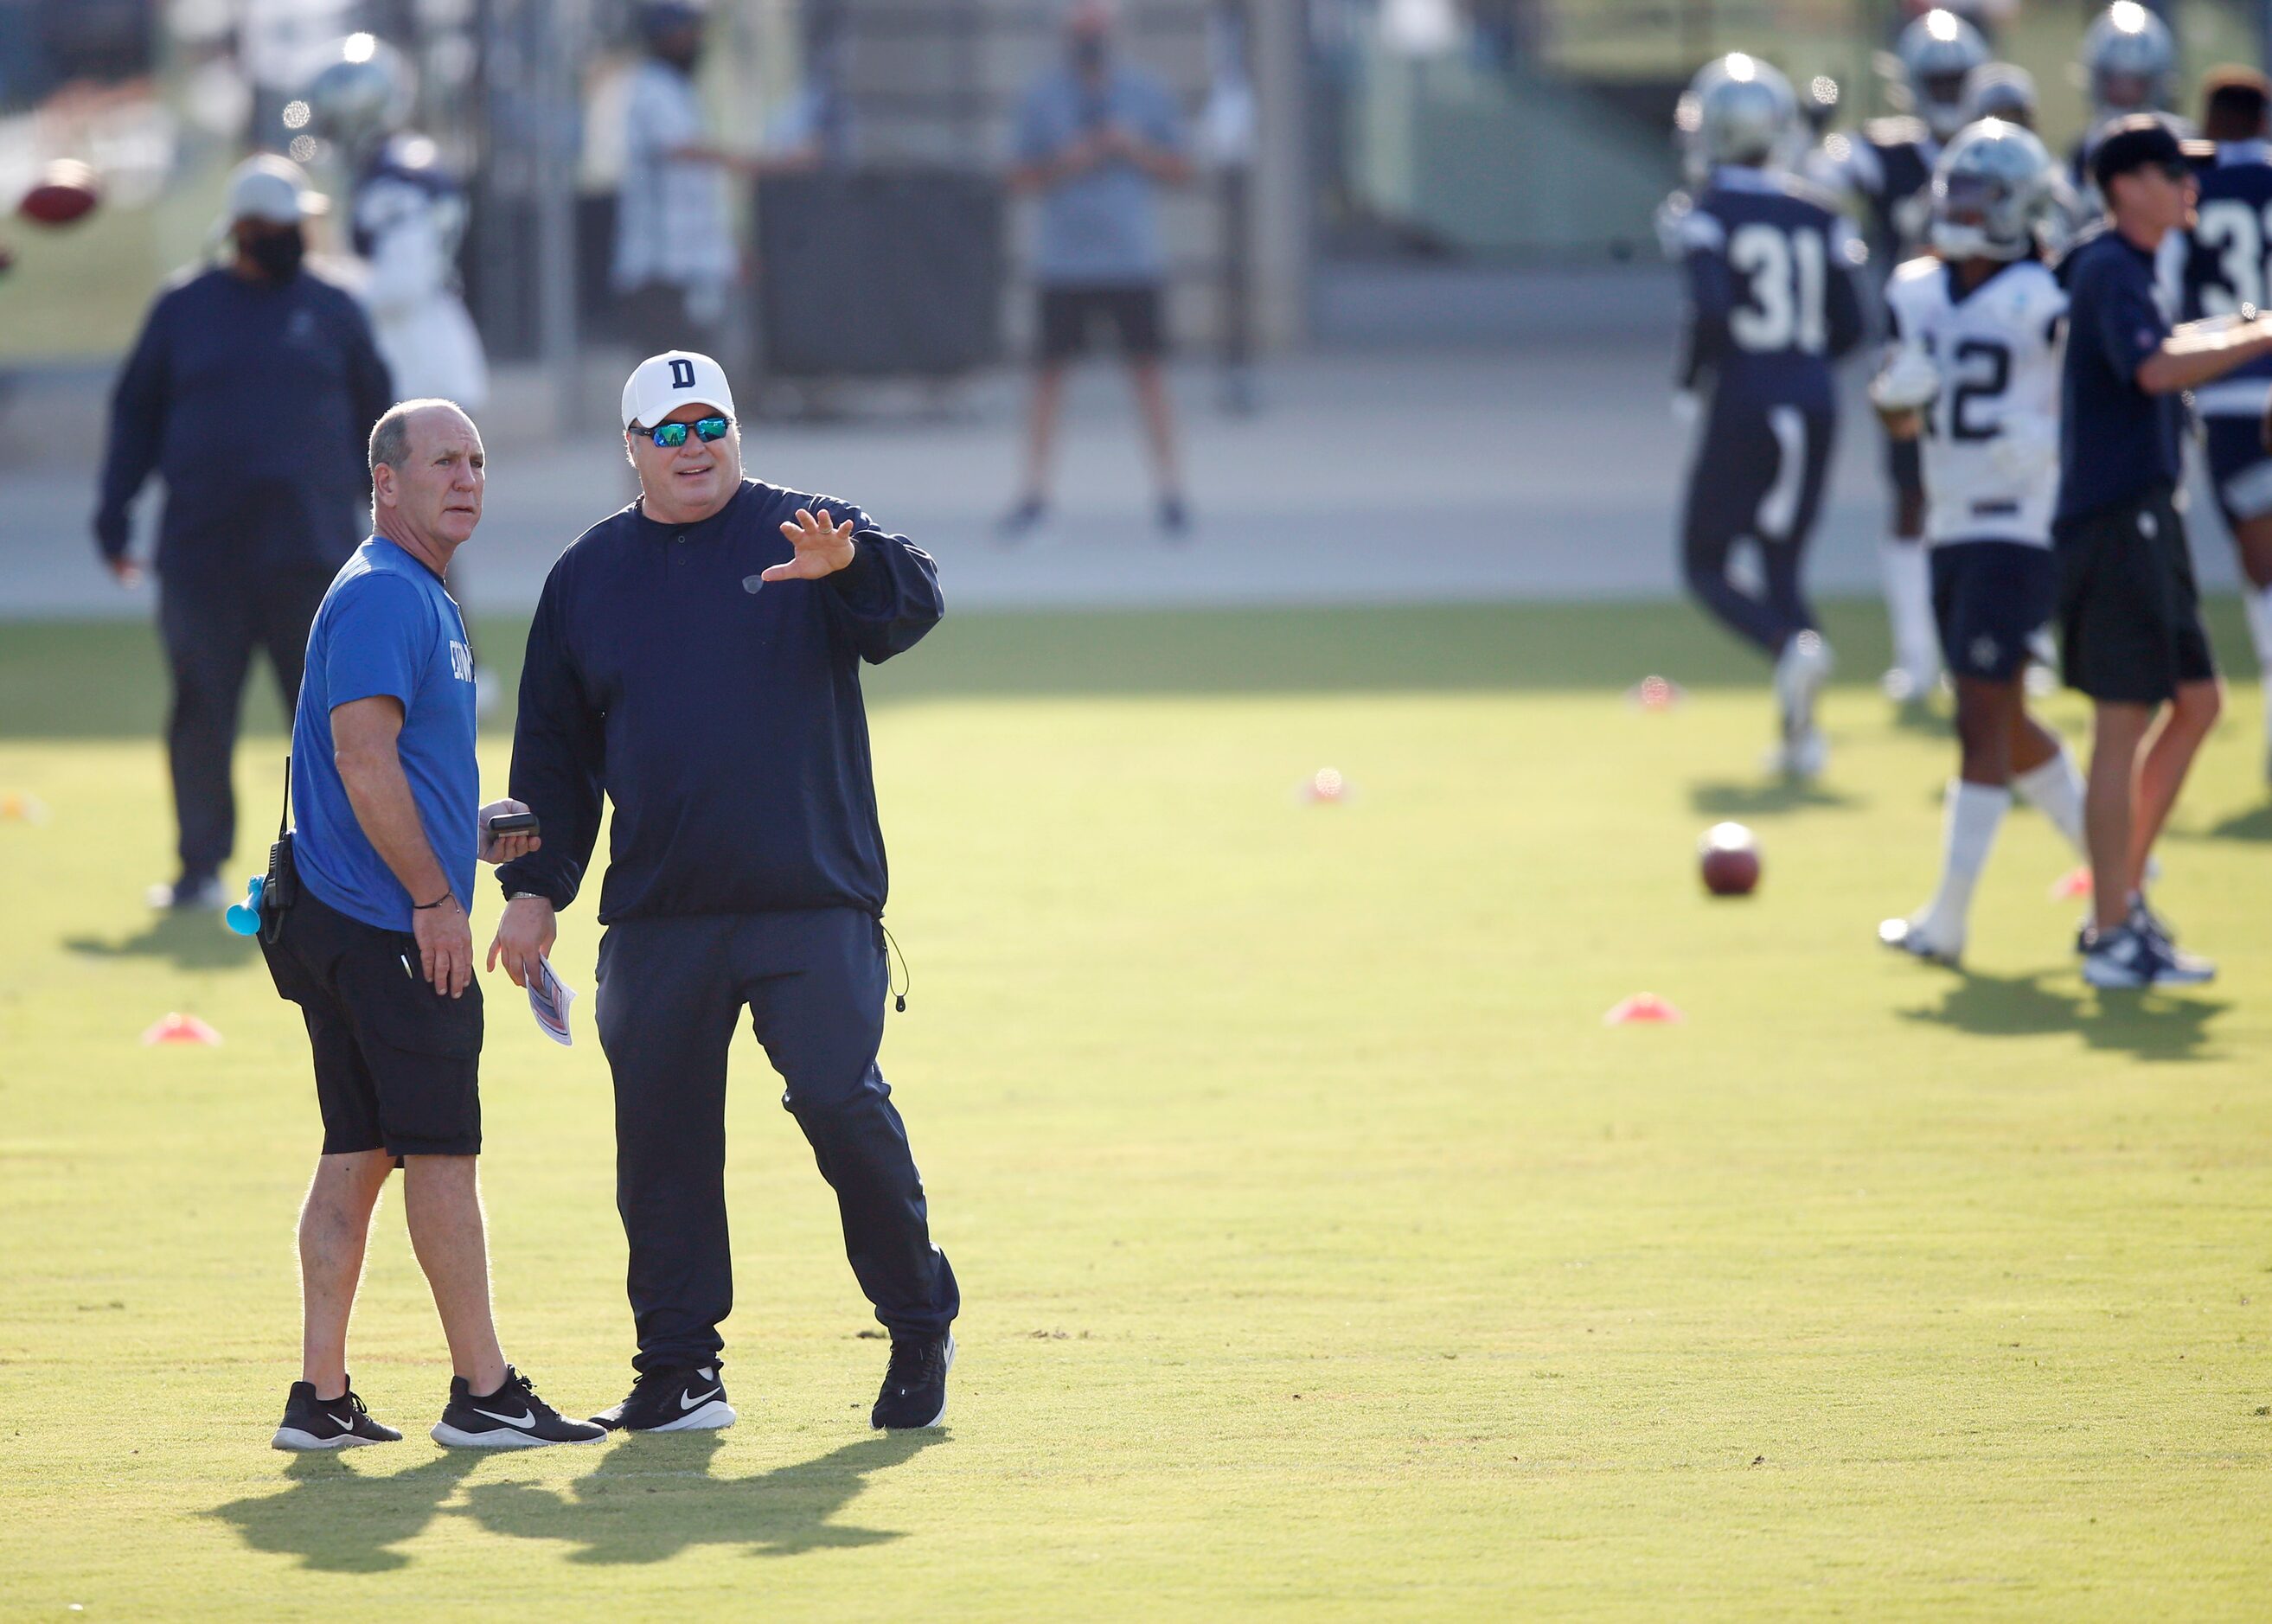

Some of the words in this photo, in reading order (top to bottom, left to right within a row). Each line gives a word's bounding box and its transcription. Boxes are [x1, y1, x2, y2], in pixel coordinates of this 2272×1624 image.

[1730, 225, 1825, 354] 31
[2197, 198, 2272, 316] 3
[669, 359, 695, 388] D
